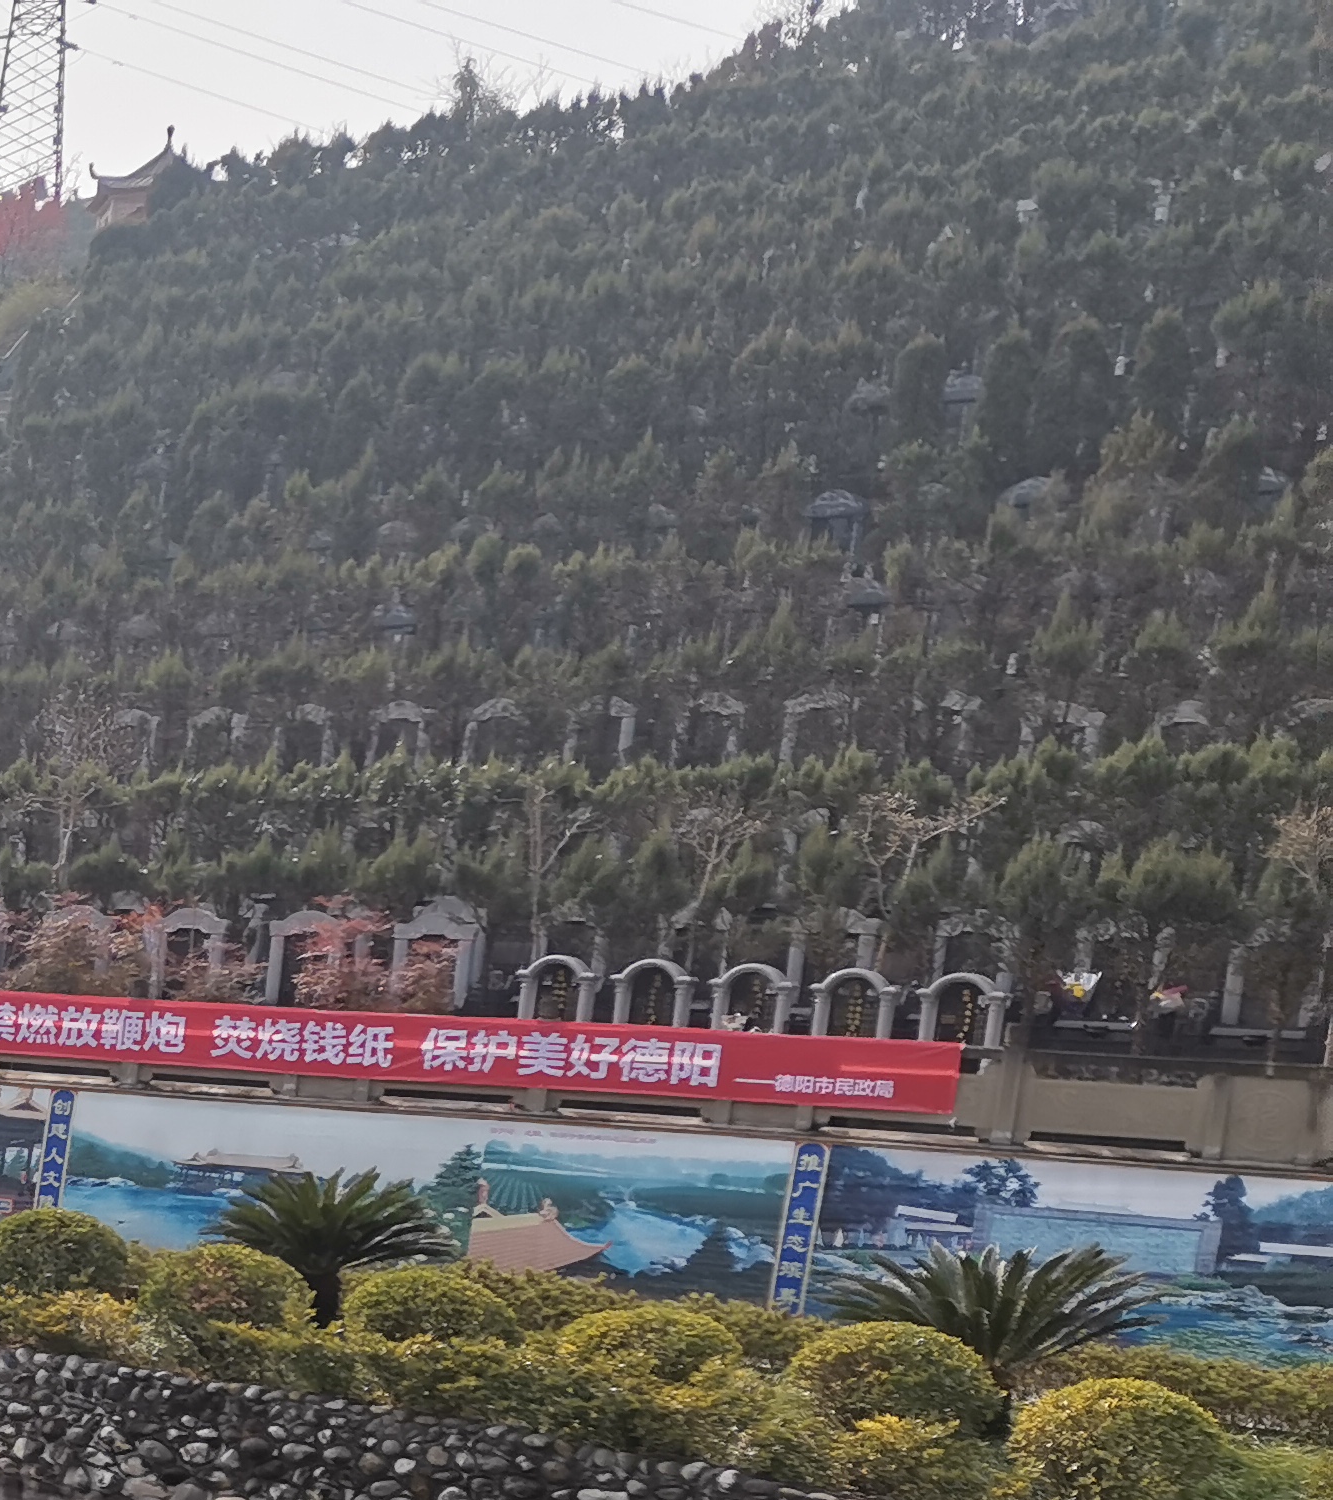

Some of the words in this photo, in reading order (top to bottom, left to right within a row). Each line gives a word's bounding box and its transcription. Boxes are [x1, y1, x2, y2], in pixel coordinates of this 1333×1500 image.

[210, 1014, 395, 1068] 焚烧钱纸
[420, 1027, 722, 1087] 保护美好德阳
